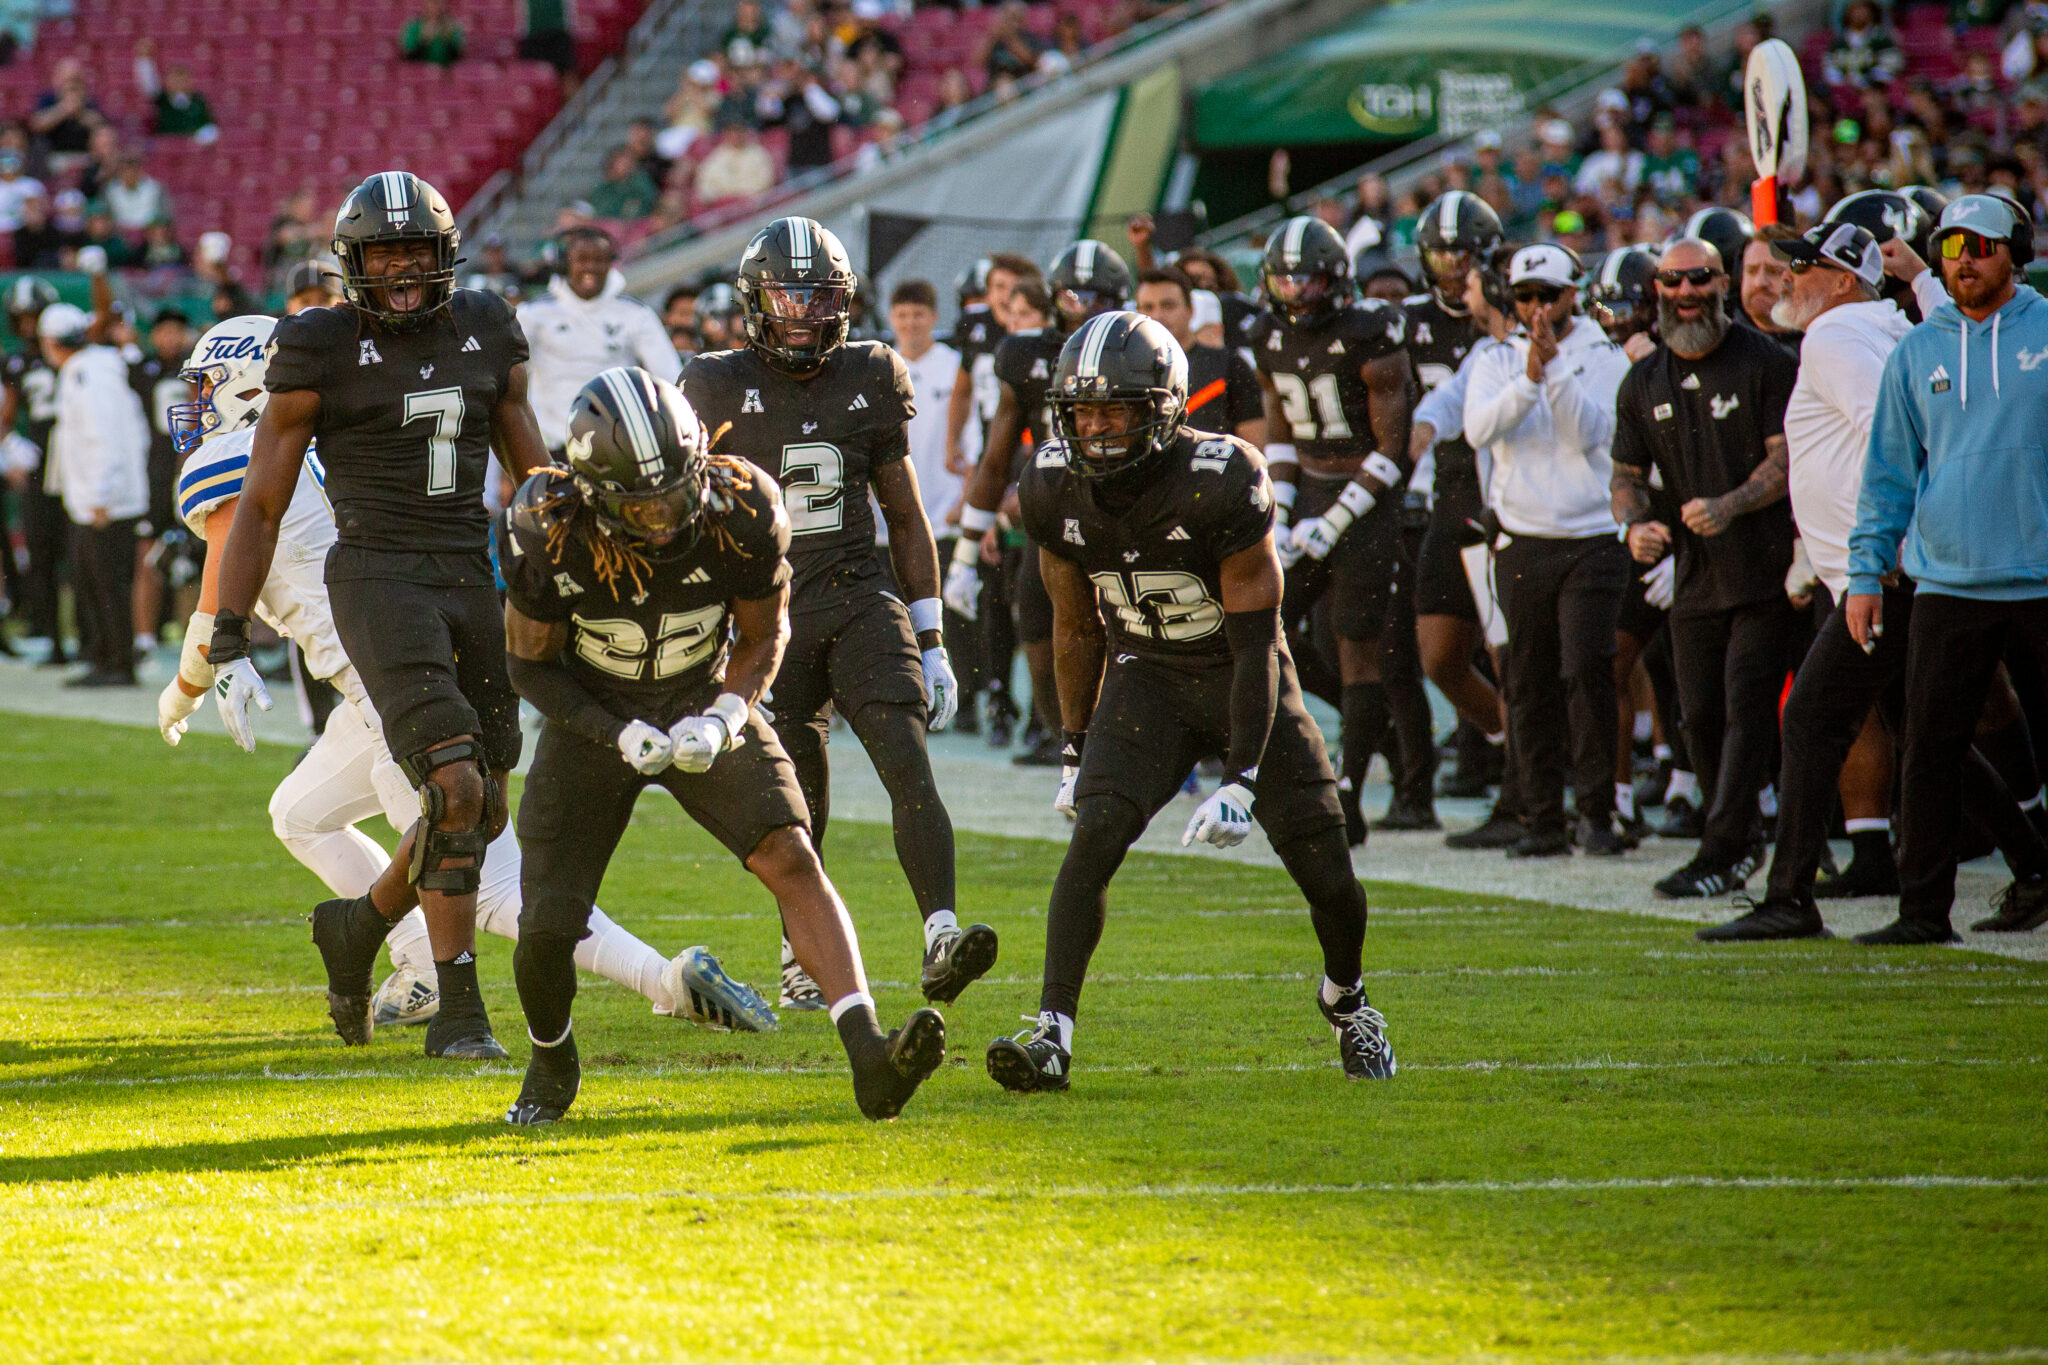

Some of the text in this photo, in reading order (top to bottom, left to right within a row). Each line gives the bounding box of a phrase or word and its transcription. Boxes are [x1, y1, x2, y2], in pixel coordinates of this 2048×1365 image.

[358, 339, 383, 366] A
[741, 388, 765, 413] A
[401, 386, 466, 496] 7
[1191, 440, 1235, 475] 13
[779, 441, 844, 536] 2
[1063, 518, 1087, 546] A
[553, 572, 584, 598] A
[1089, 571, 1225, 642] 13
[571, 601, 726, 680] 22
